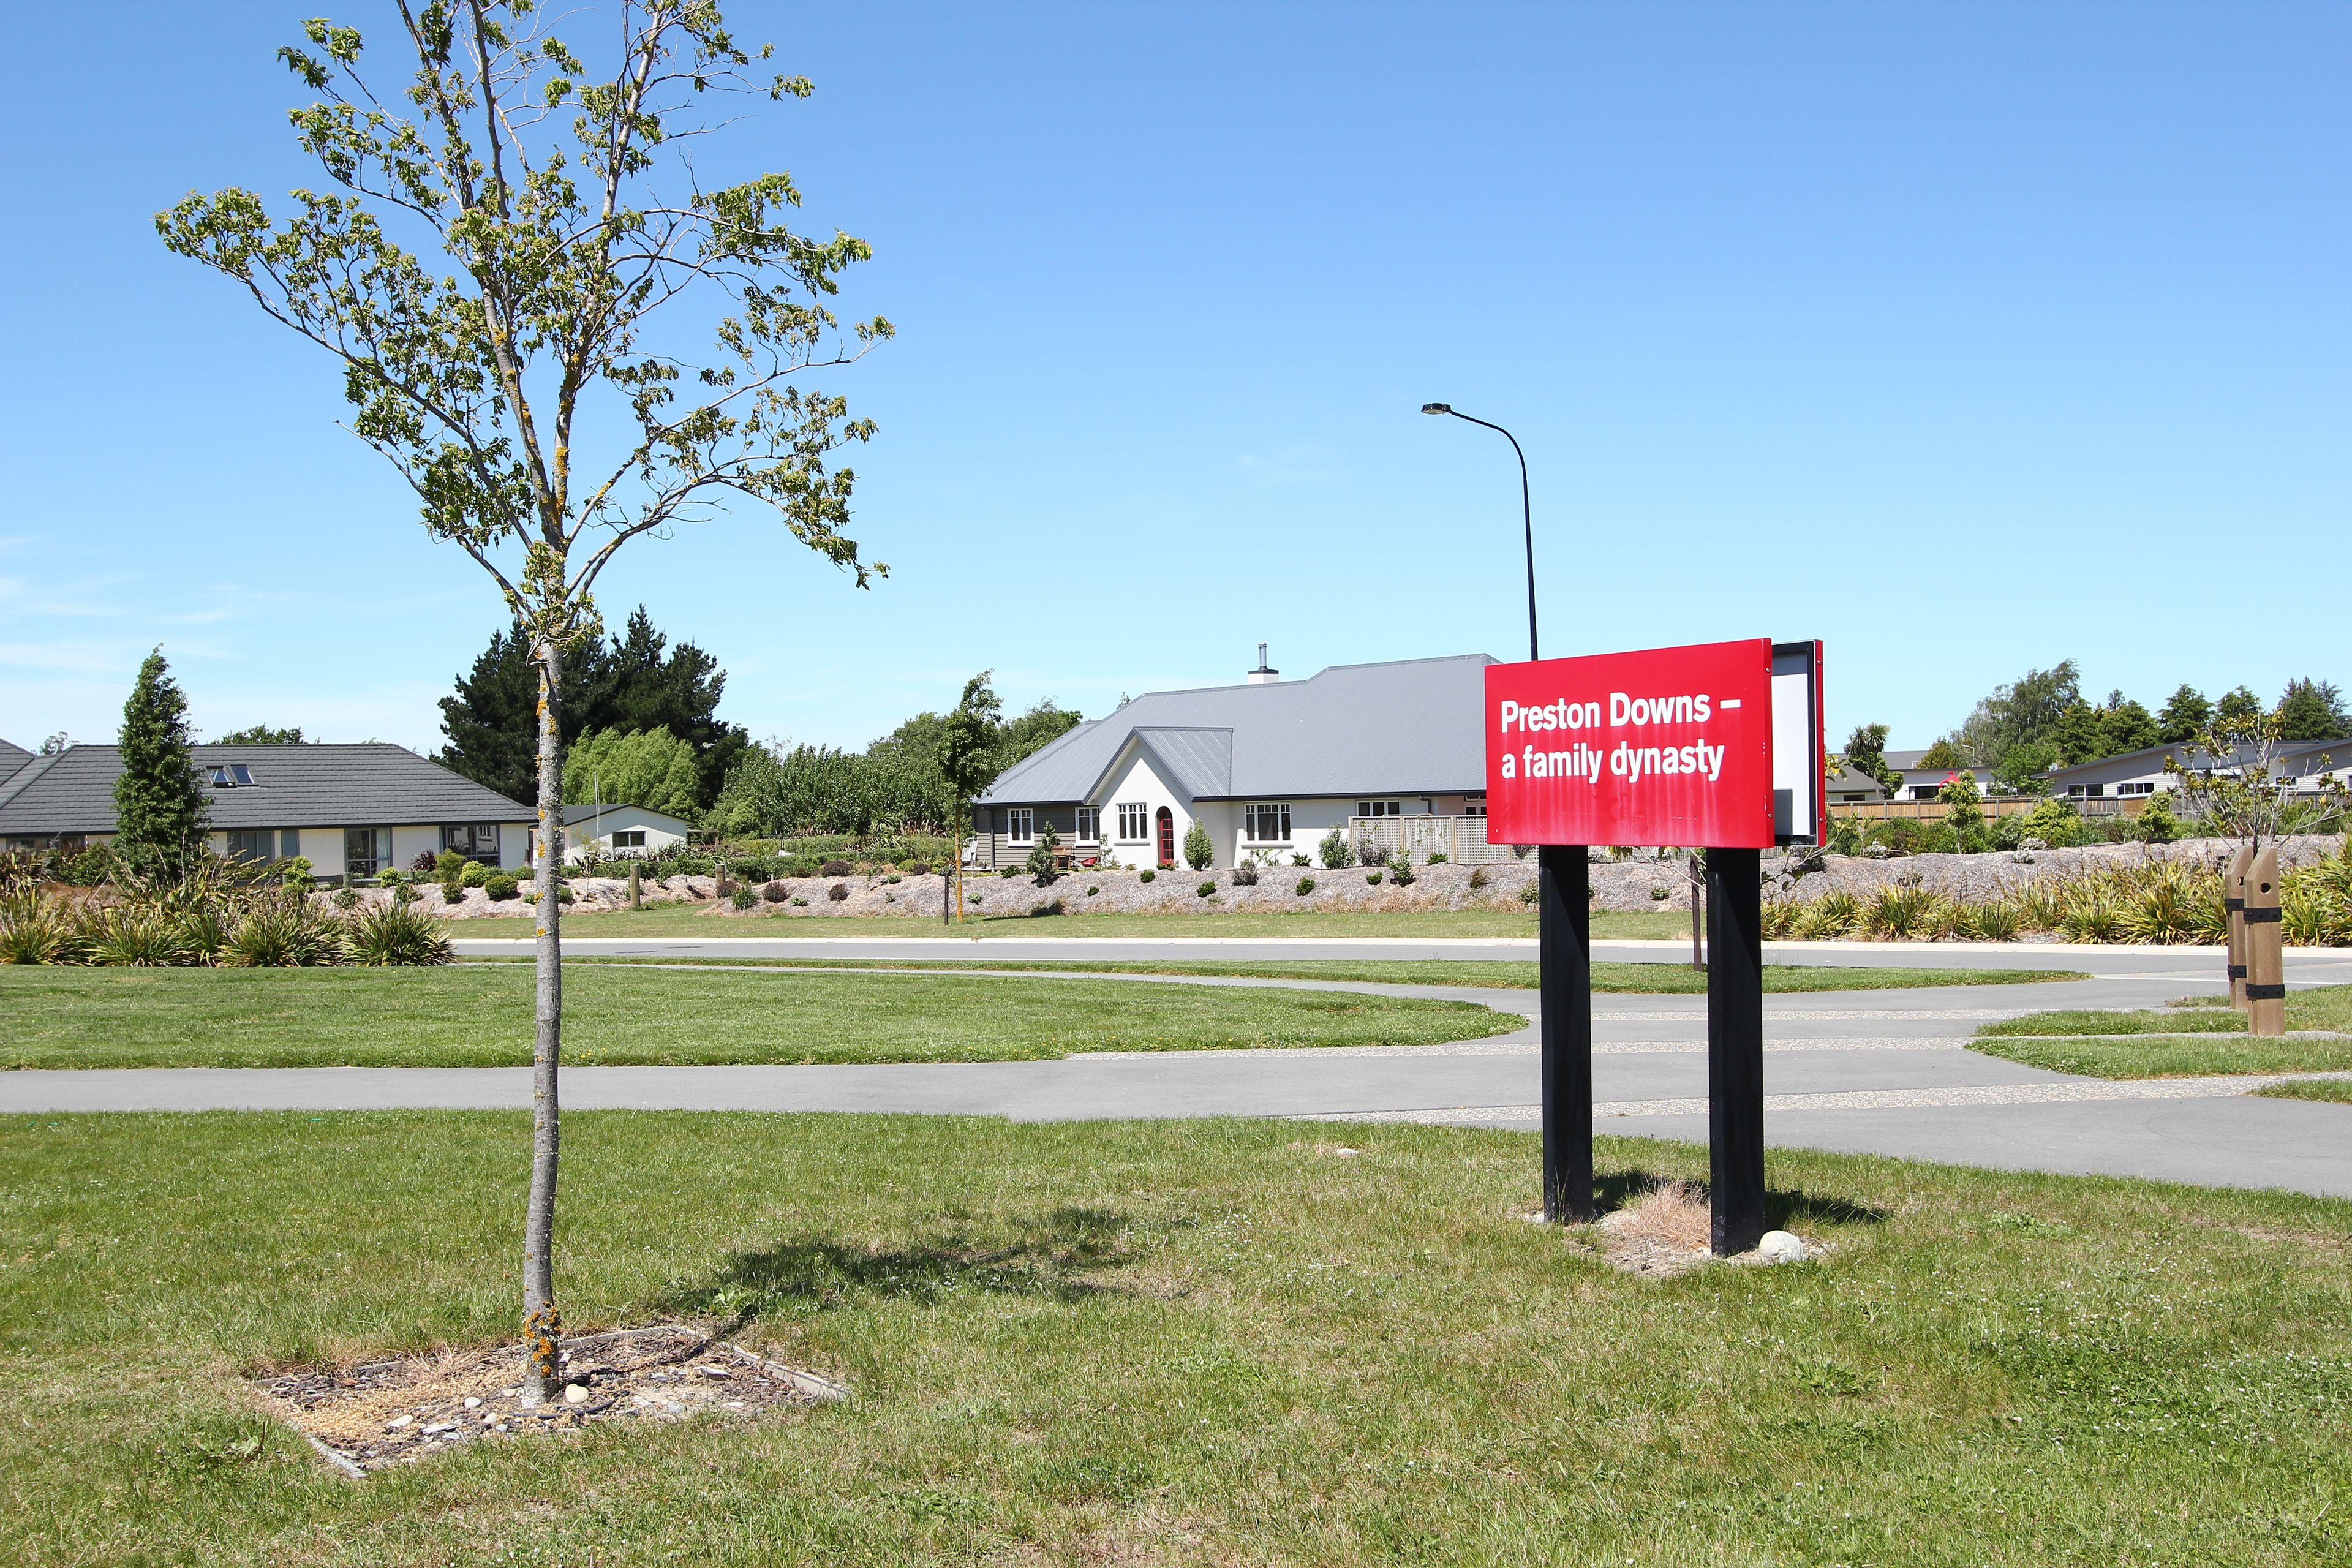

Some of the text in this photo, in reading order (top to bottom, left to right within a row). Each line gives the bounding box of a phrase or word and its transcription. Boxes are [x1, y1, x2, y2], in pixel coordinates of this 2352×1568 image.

[1501, 697, 1600, 733] Preston
[1610, 692, 1711, 727] Downs
[1501, 739, 1725, 784] a family dynasty
